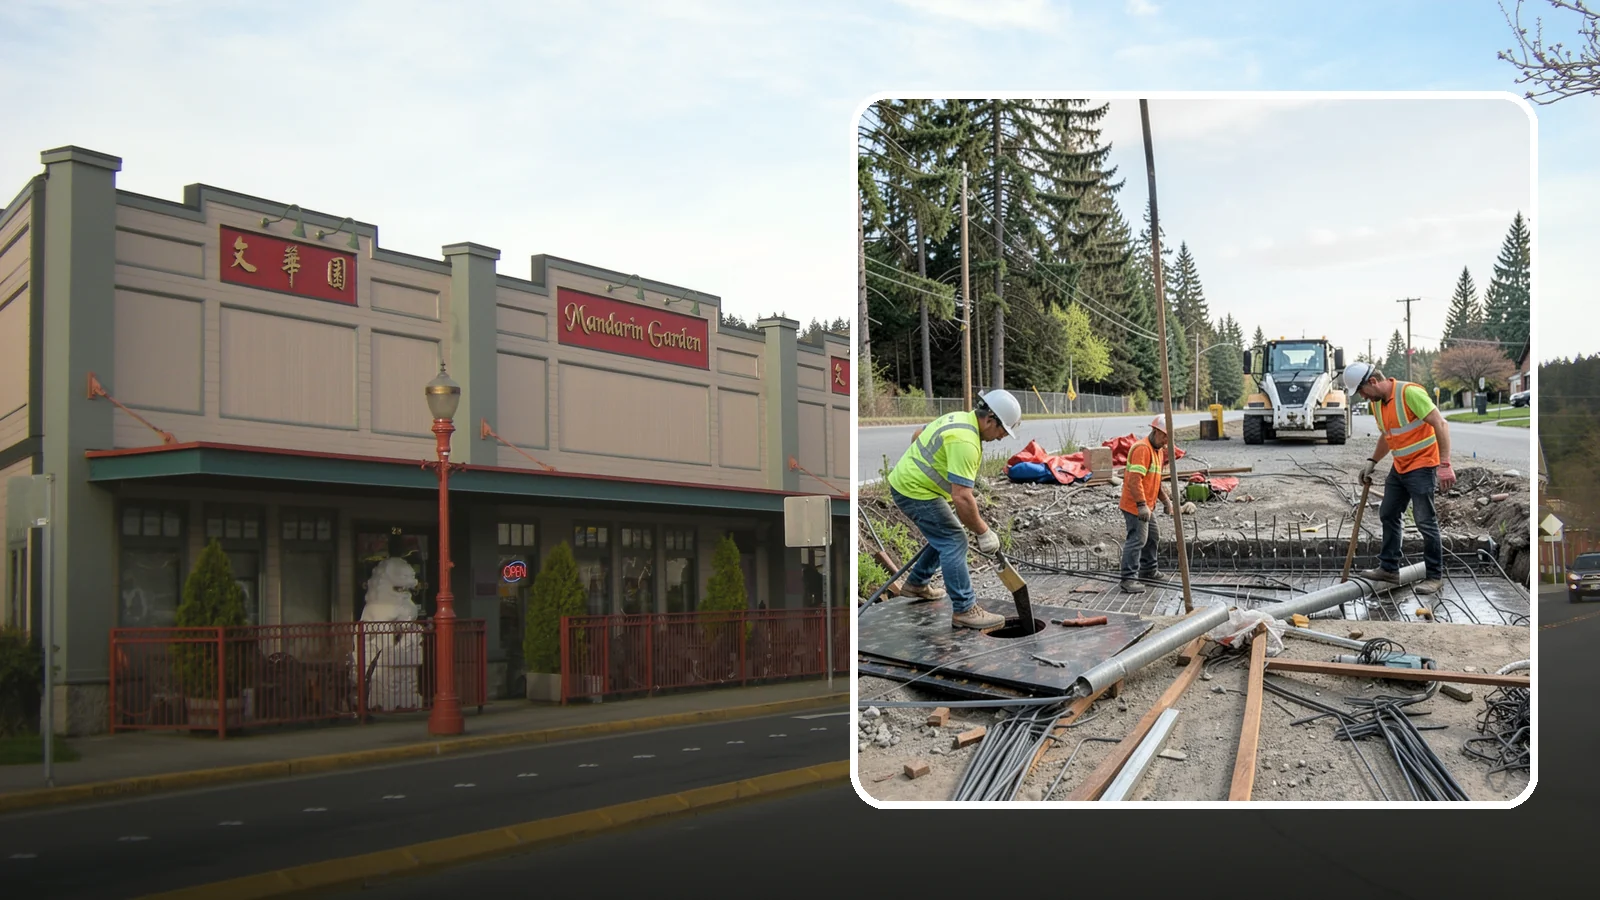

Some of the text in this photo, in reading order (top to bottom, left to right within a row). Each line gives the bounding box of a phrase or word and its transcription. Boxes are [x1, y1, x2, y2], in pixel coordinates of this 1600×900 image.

[564, 302, 702, 352] Mandarin Garden
[503, 565, 527, 578] OPEN
